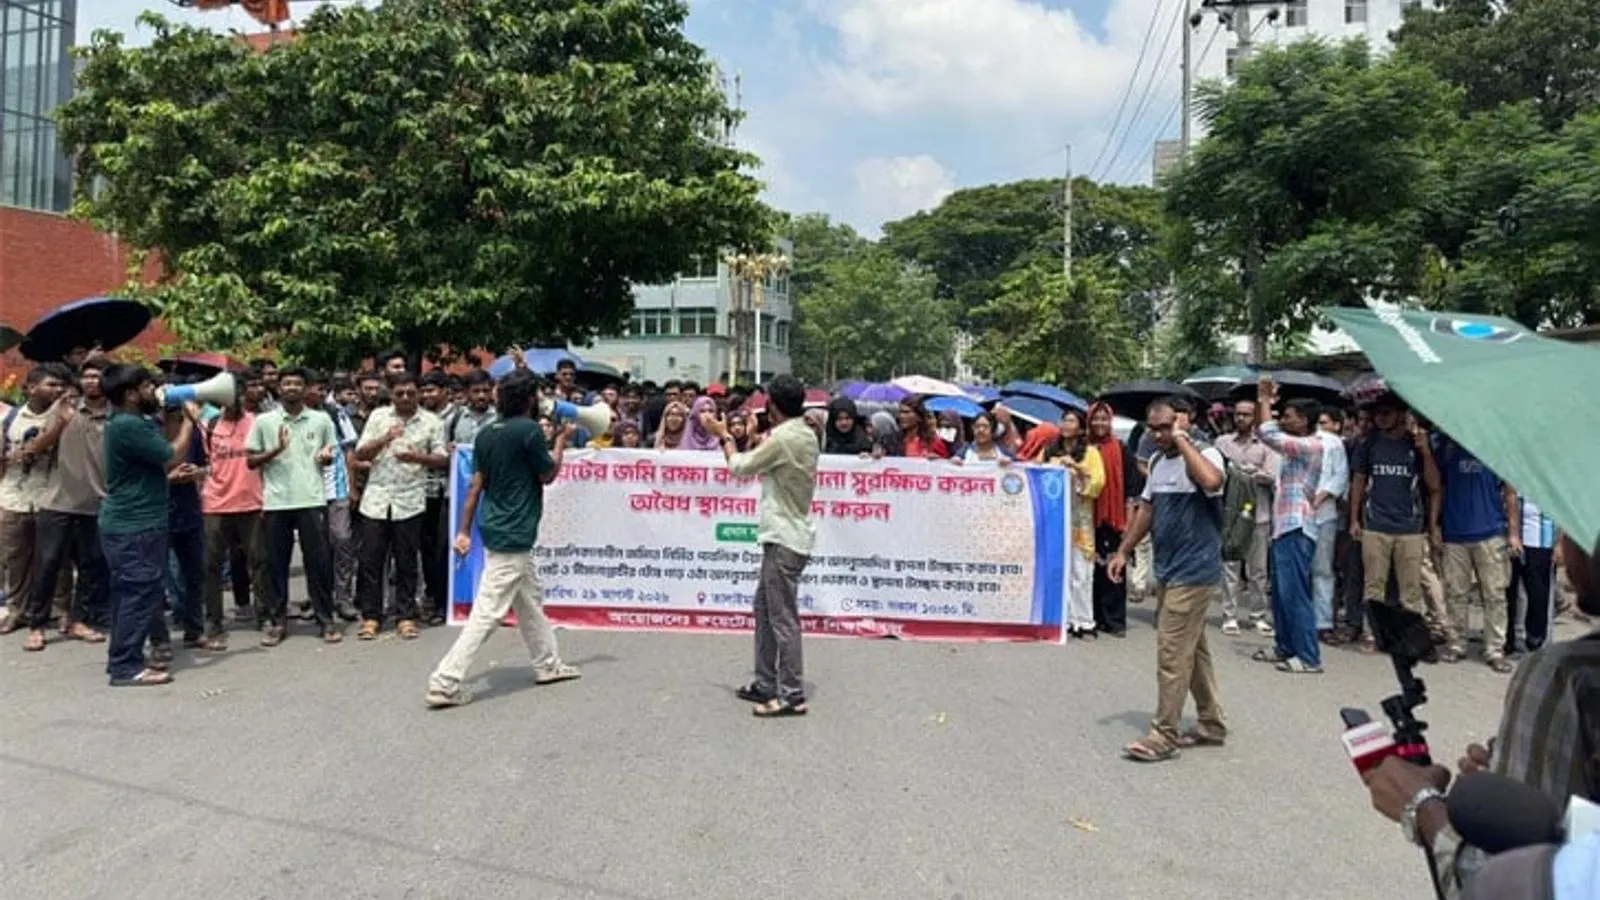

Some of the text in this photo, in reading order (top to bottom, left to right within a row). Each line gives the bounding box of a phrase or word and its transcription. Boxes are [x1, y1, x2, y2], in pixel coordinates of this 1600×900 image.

[613, 459, 656, 481] জমি
[937, 476, 995, 495] করুন
[630, 489, 690, 511] অবৈধ
[695, 495, 757, 518] স্থাপনা
[831, 501, 890, 521] করুন
